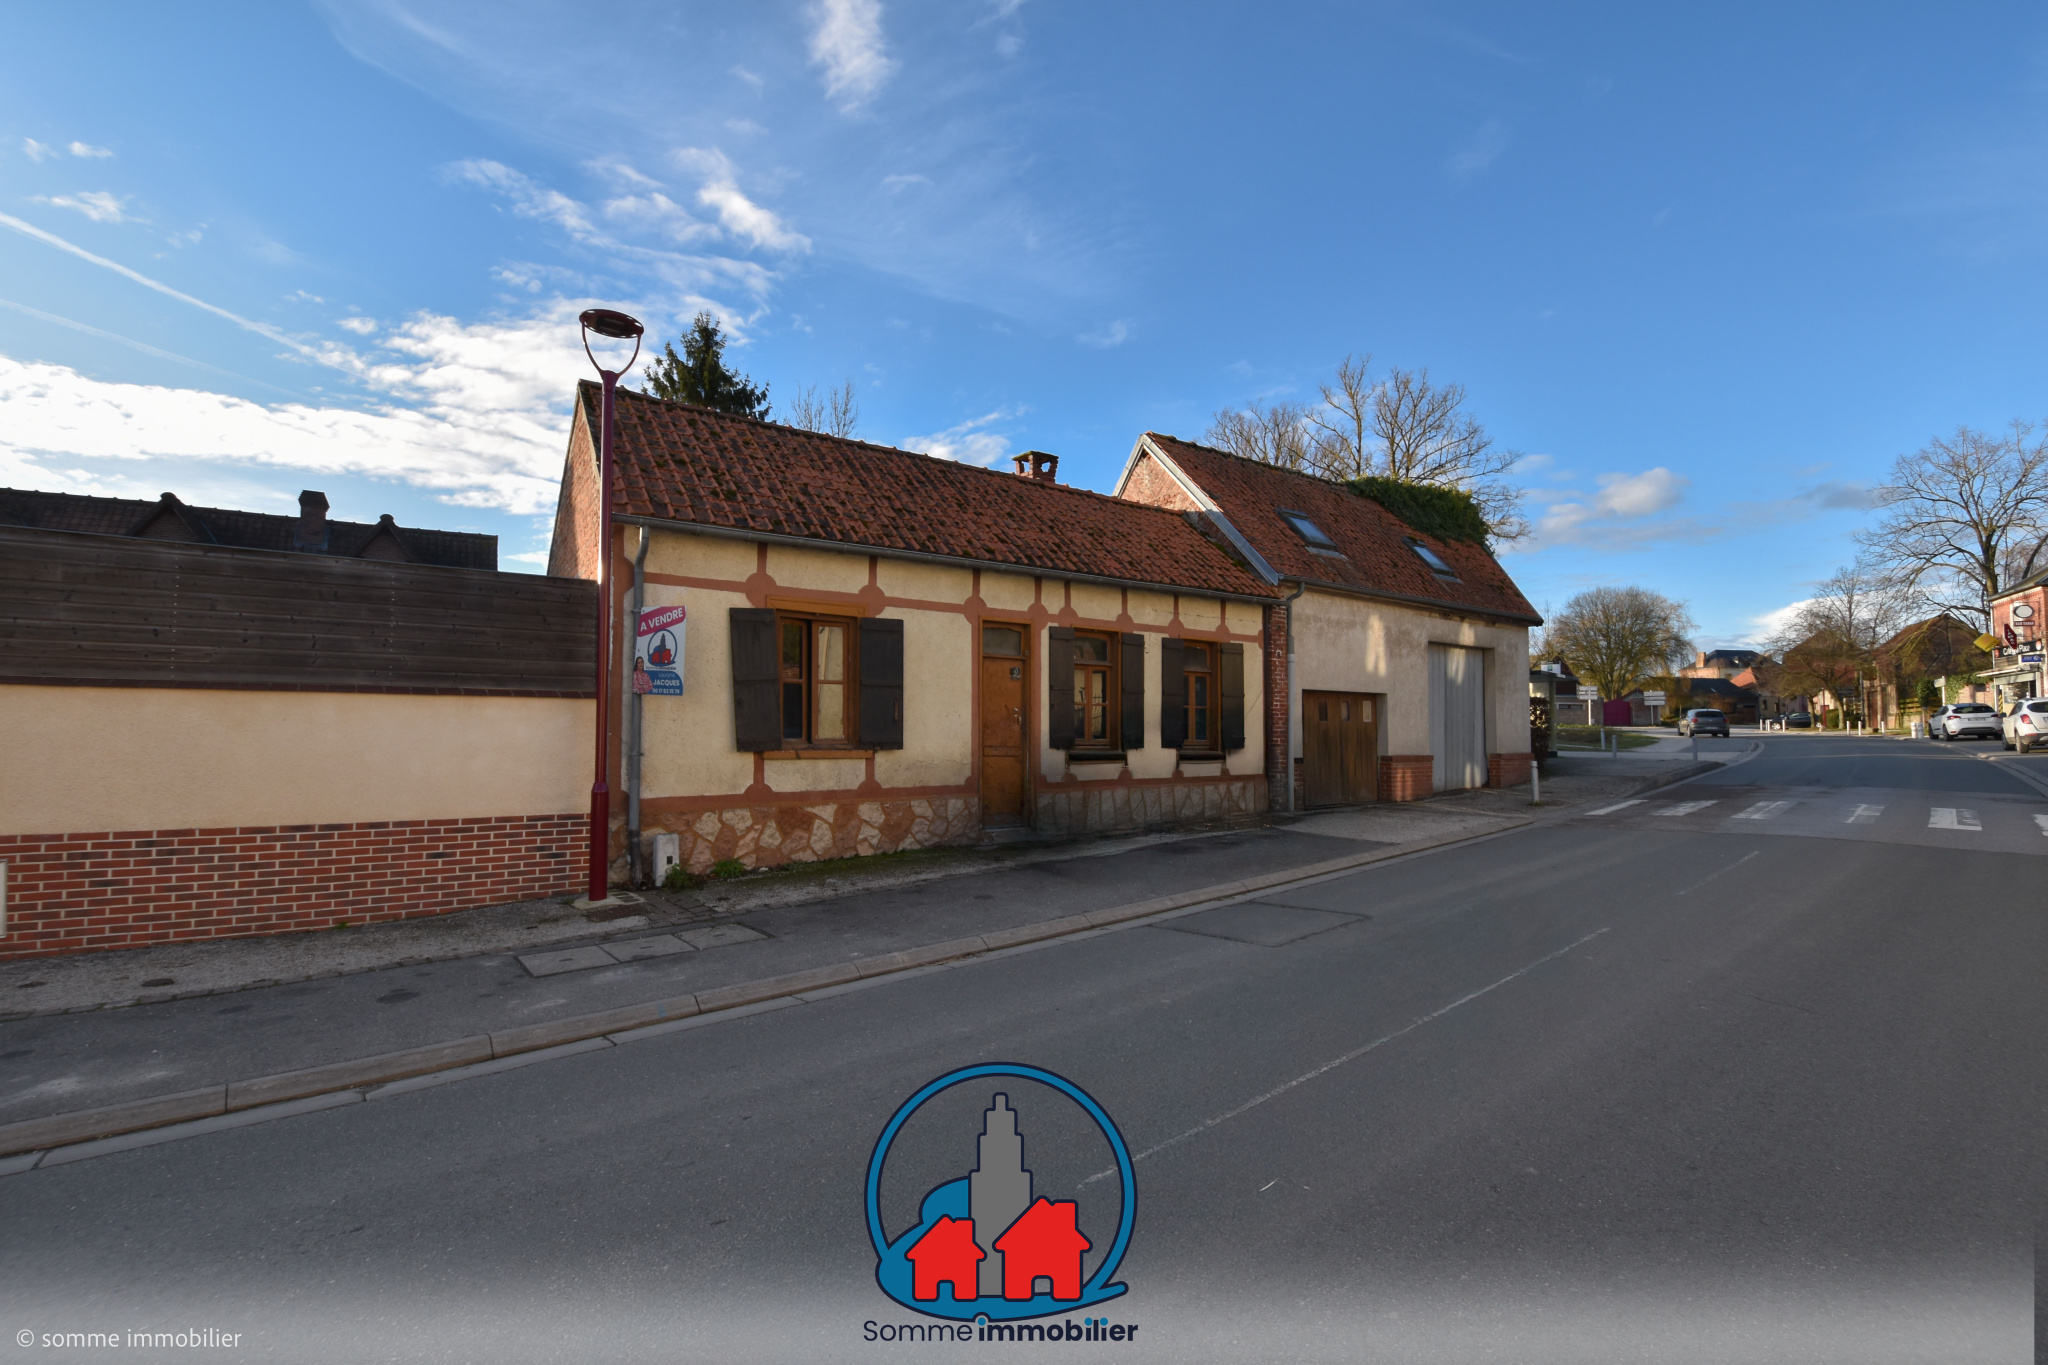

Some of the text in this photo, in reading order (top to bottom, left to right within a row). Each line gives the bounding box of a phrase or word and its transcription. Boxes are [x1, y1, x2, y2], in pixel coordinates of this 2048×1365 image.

[640, 607, 683, 632] A VENDRE
[653, 679, 680, 687] JACQUES
